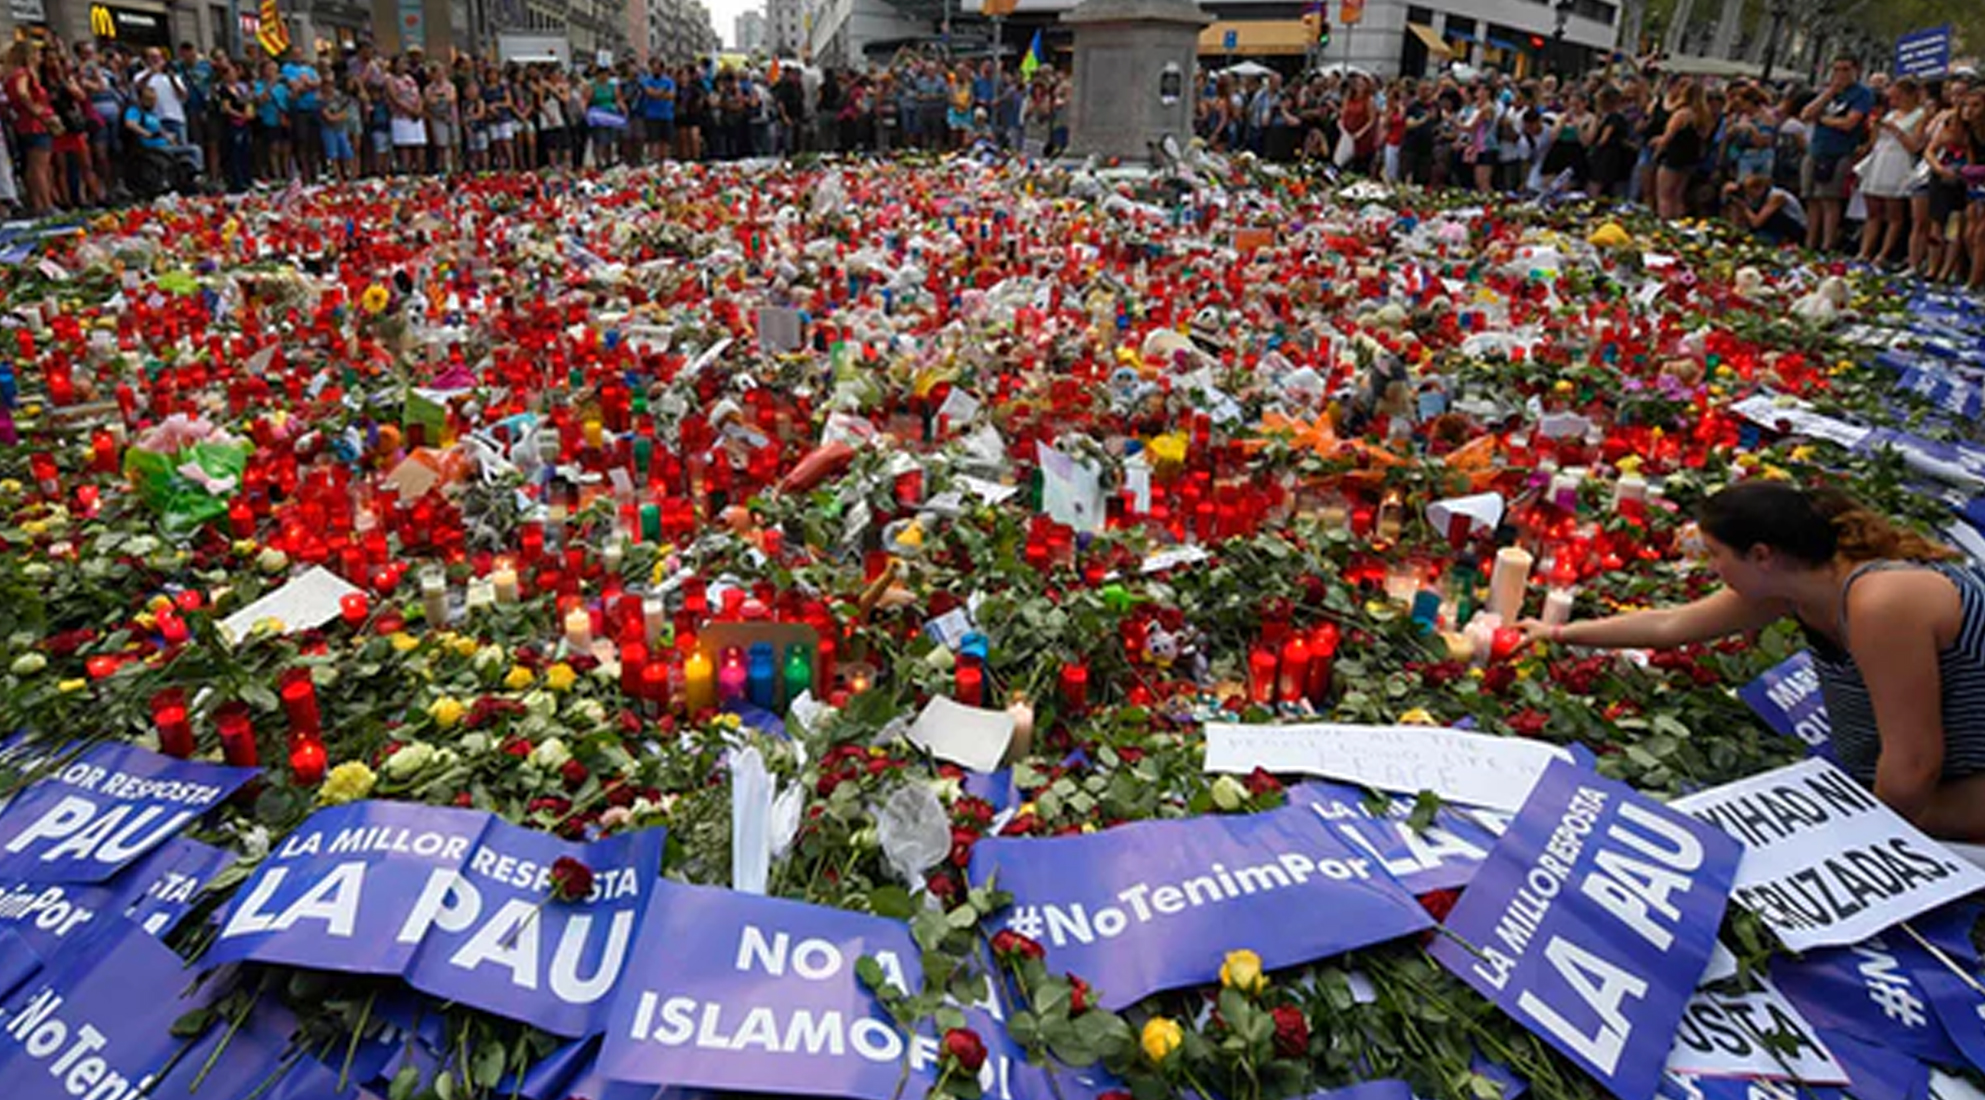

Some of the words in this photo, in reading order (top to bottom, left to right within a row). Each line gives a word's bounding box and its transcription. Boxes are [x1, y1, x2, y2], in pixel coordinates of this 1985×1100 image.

[5, 794, 195, 863] PAU
[1803, 769, 1877, 818] NI
[279, 831, 322, 858] LA
[328, 826, 469, 860] MILLOR
[470, 844, 639, 904] RESPSTA
[1006, 852, 1372, 946] #NoTenimPor
[1580, 801, 1704, 952] PAU
[222, 861, 367, 939] LA
[397, 867, 636, 1004] PAU
[735, 925, 842, 980] NO
[1472, 946, 1516, 990] LA
[1495, 855, 1573, 955] MILLOR
[1517, 935, 1648, 1076] LA
